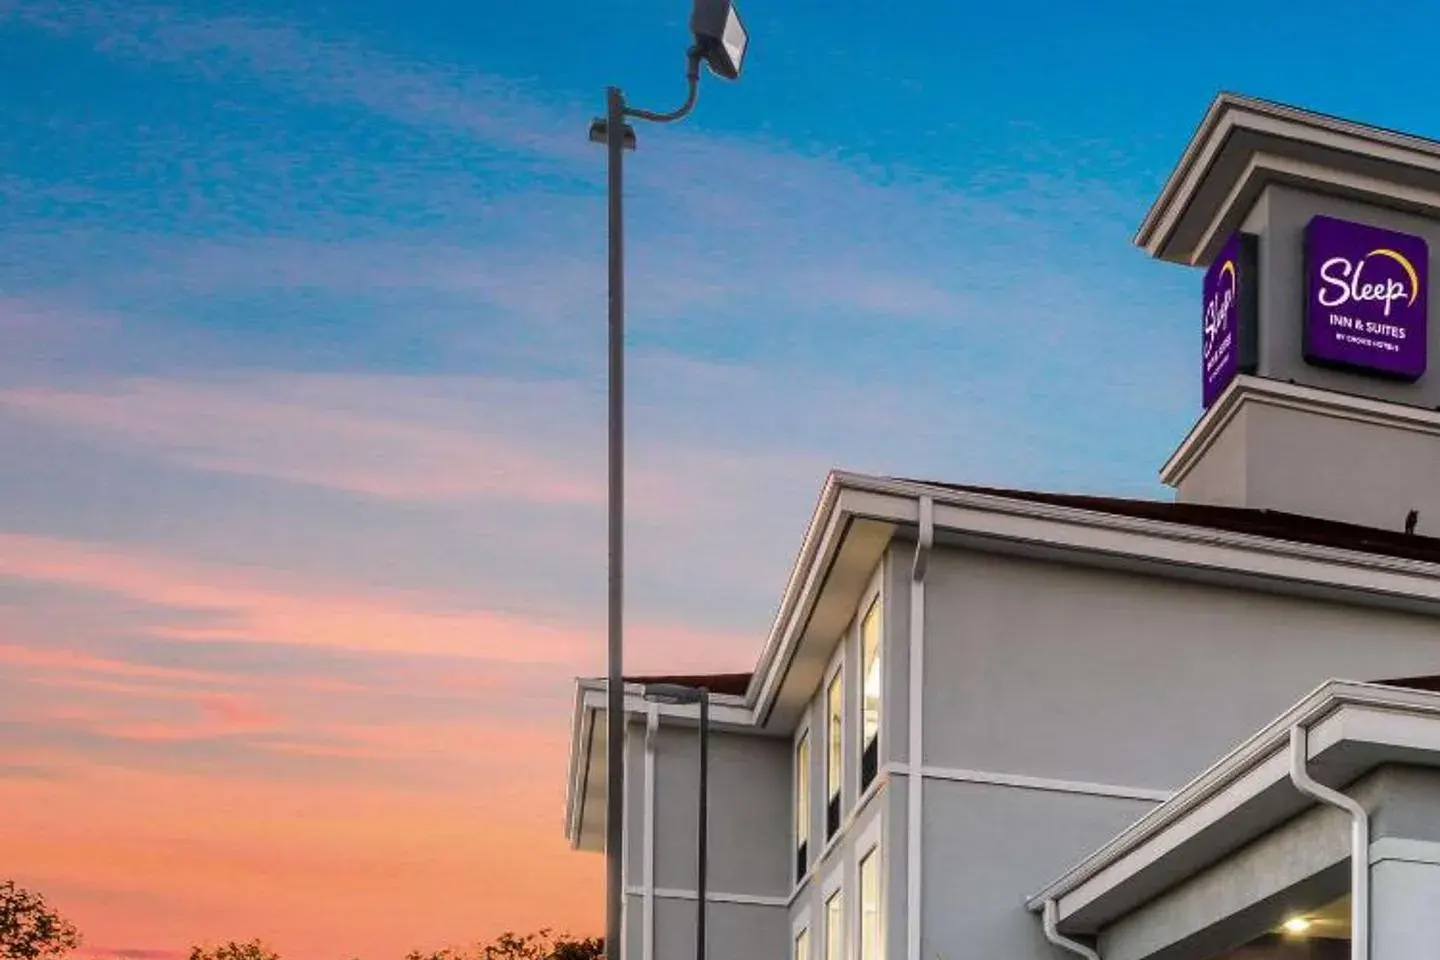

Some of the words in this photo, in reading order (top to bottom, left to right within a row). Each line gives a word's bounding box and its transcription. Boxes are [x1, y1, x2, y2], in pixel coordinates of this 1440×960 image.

[1318, 257, 1409, 316] Sleep
[1329, 314, 1353, 328] INN
[1355, 319, 1364, 331] &
[1365, 322, 1406, 339] SUITES
